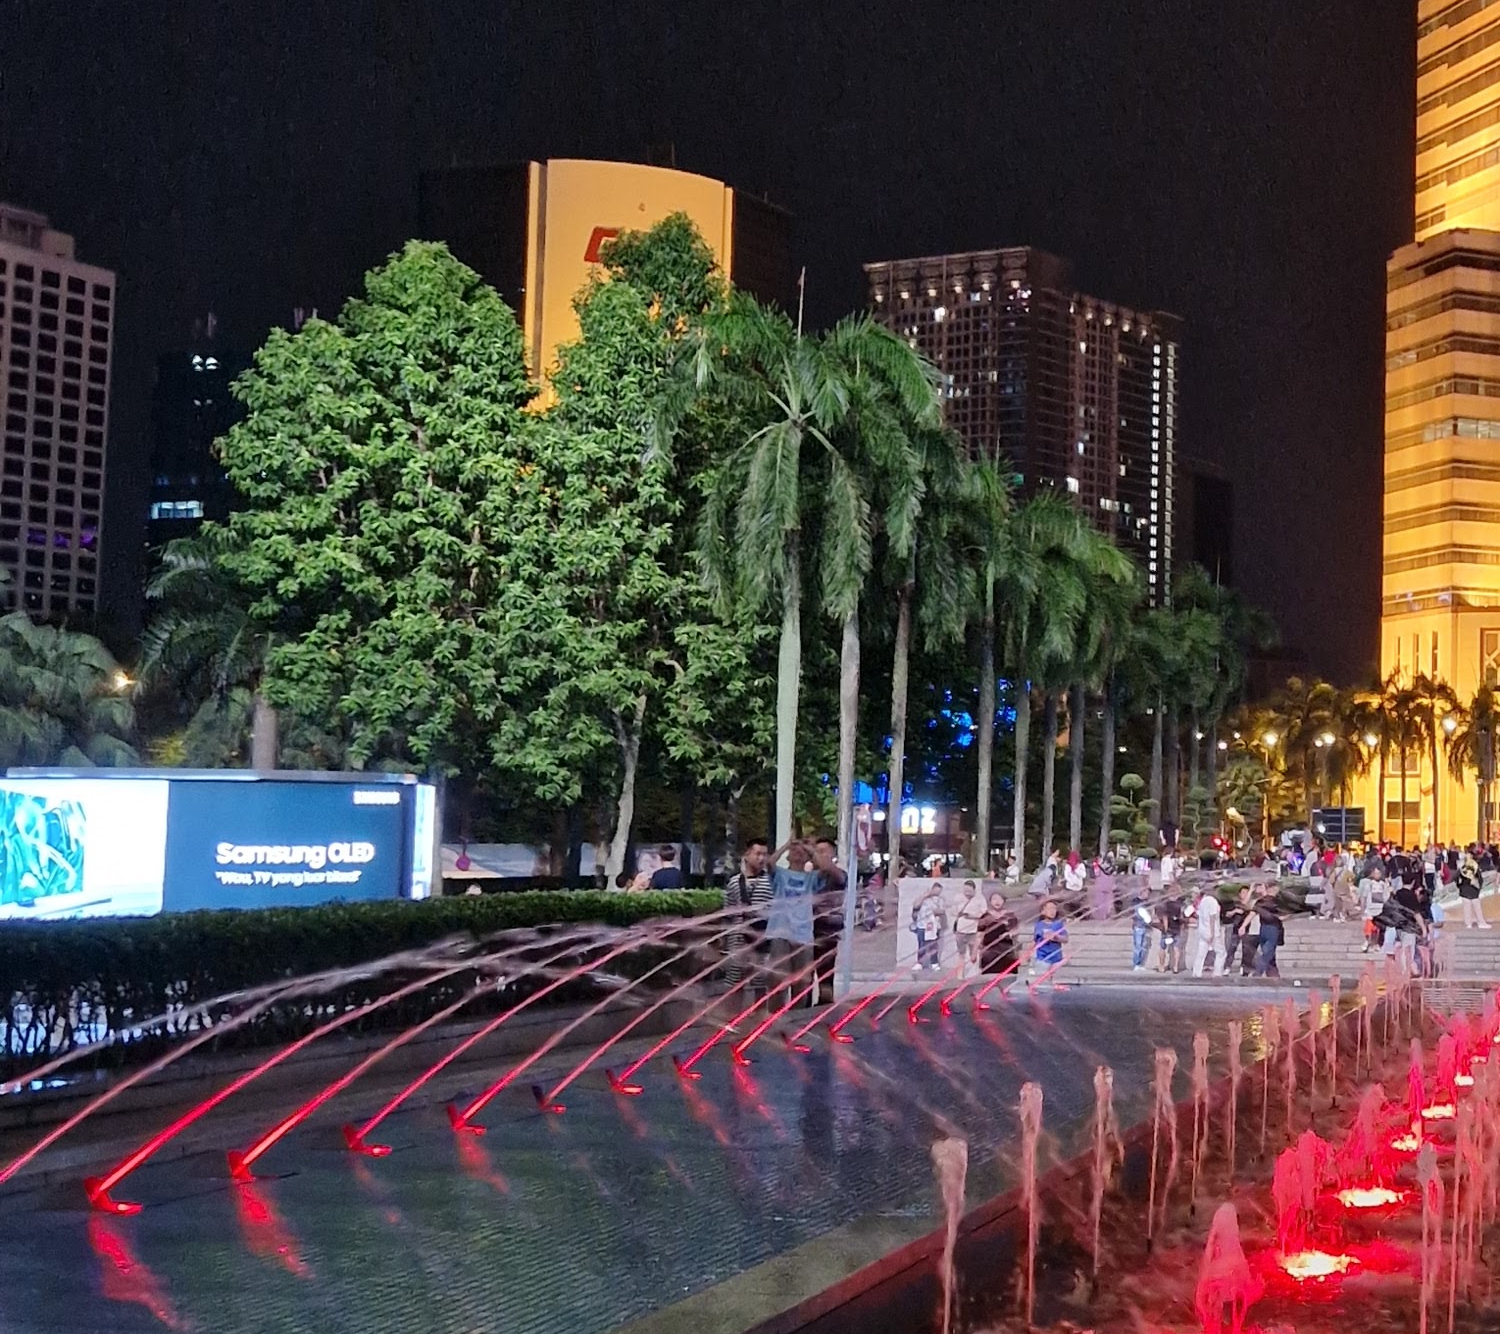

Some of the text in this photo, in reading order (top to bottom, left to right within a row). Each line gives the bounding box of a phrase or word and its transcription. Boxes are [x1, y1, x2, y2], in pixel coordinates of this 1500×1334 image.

[215, 842, 375, 869] Samsung OLED
[253, 871, 272, 885] TV
